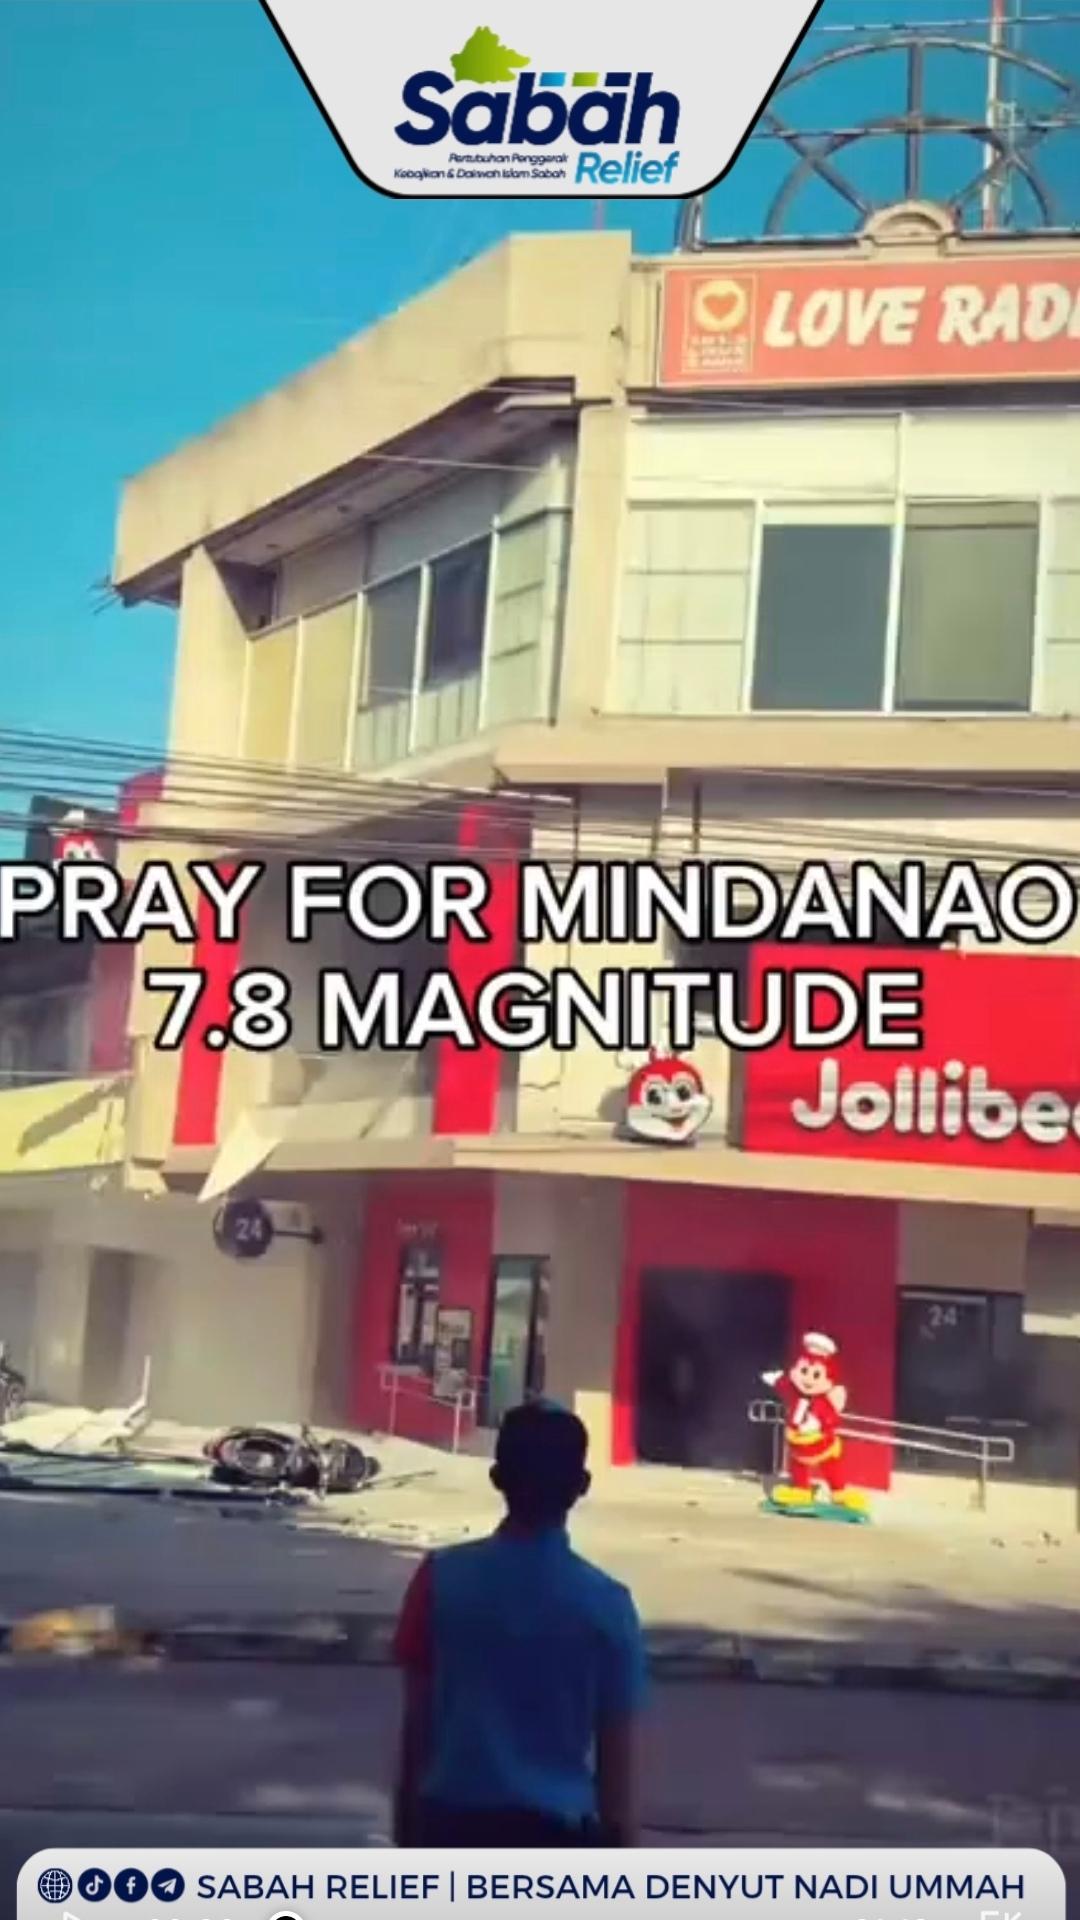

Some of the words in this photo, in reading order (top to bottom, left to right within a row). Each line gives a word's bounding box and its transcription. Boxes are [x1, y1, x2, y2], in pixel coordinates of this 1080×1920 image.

[763, 287, 926, 347] LOVE
[791, 1057, 1080, 1144] Jollibe
[235, 1218, 264, 1242] 24
[928, 1303, 957, 1327] 24
